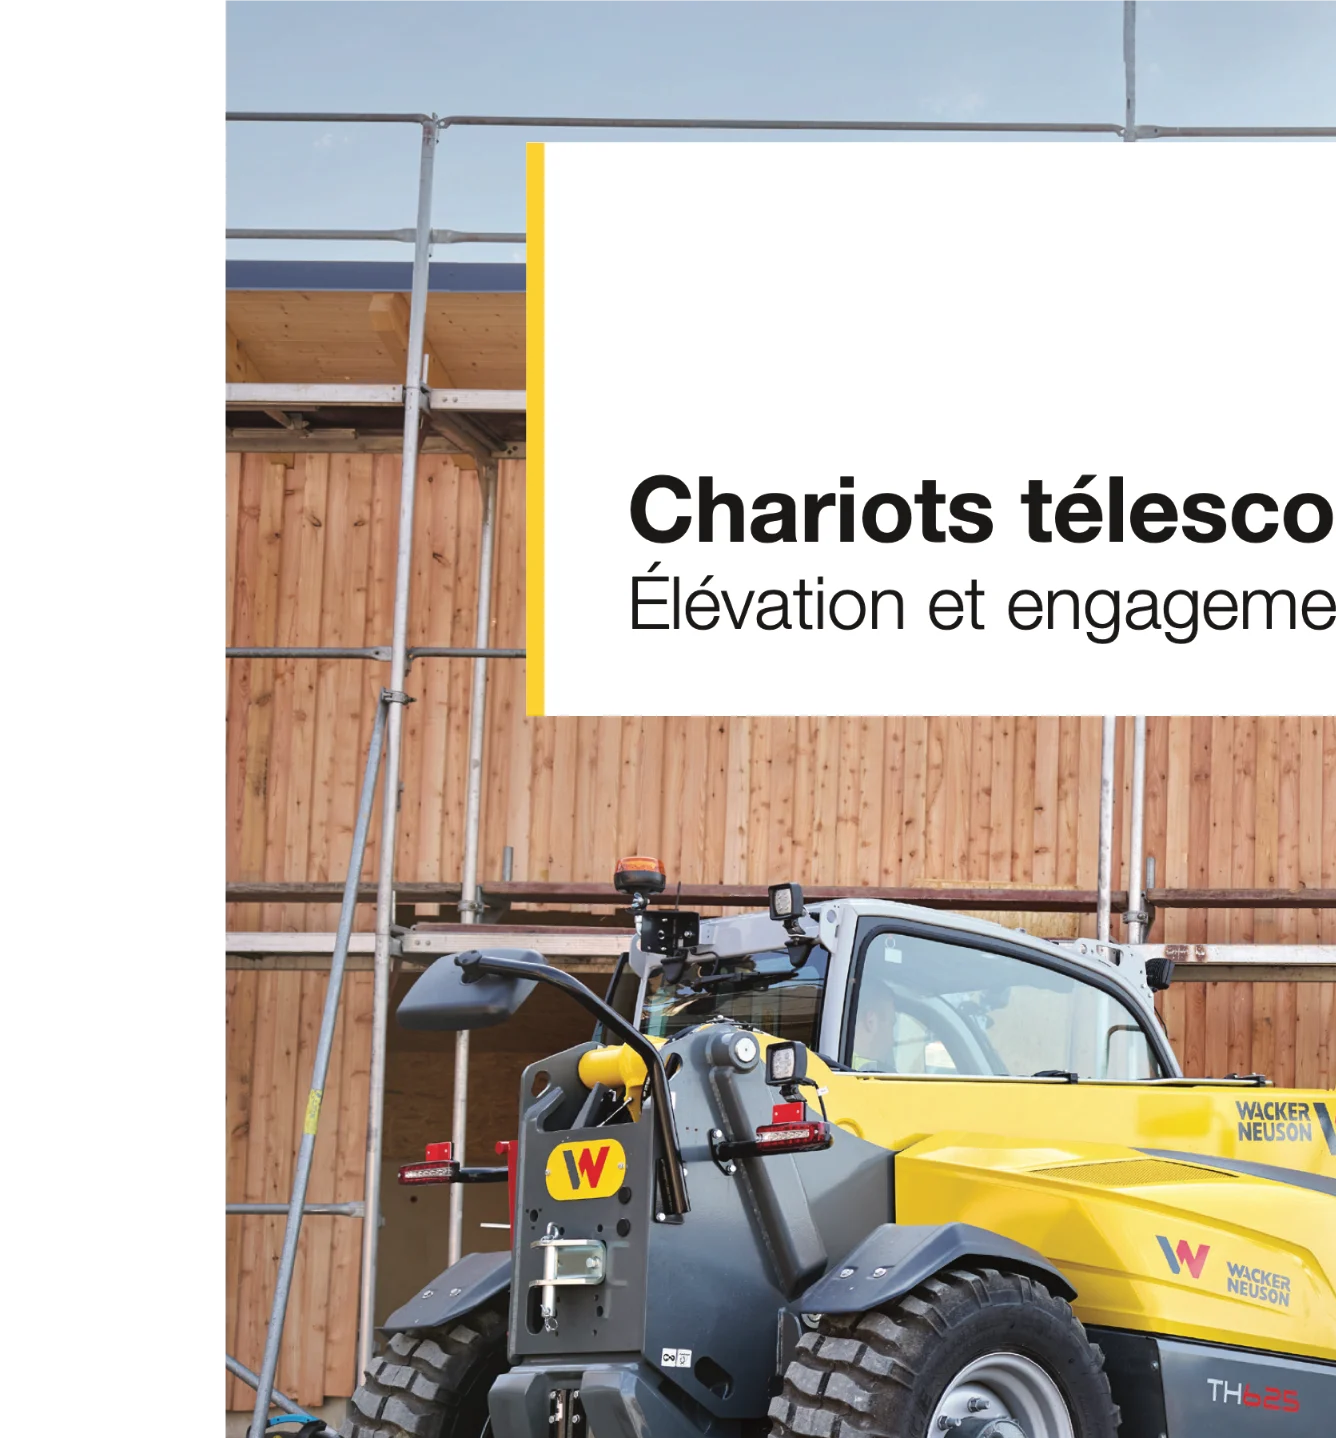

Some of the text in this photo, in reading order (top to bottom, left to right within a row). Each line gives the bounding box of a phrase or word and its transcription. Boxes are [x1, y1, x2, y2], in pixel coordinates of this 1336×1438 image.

[1235, 1101, 1311, 1121] WACKER
[1238, 1122, 1312, 1142] NEUSON
[563, 1145, 610, 1190] W
[1226, 1261, 1291, 1292] WACKER
[1227, 1277, 1290, 1308] NEUSON
[1207, 1378, 1300, 1413] TH625
